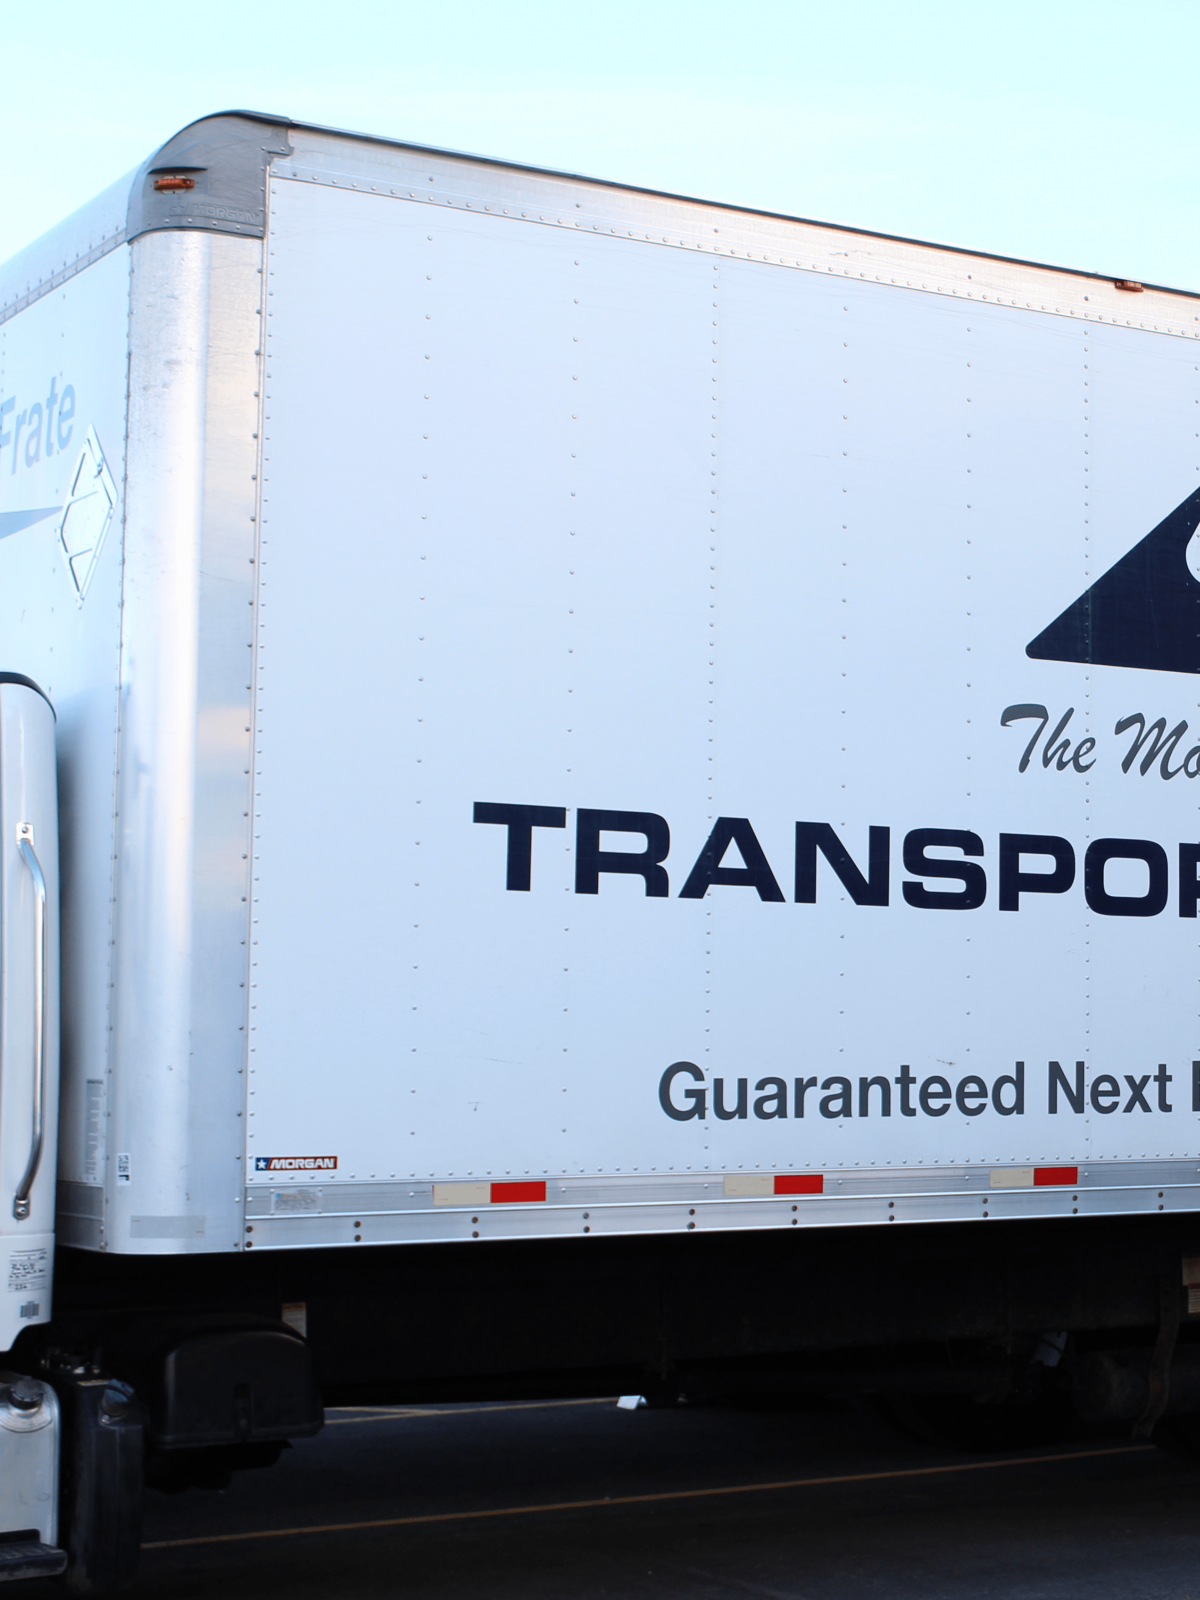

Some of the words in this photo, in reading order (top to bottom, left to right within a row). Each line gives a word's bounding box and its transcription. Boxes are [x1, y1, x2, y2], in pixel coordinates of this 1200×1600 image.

[191, 203, 259, 223] MORGAN
[1001, 703, 1097, 774] The
[658, 1061, 1025, 1122] Guaranteed
[1047, 1060, 1173, 1116] Next
[270, 1157, 335, 1170] MORGAN
